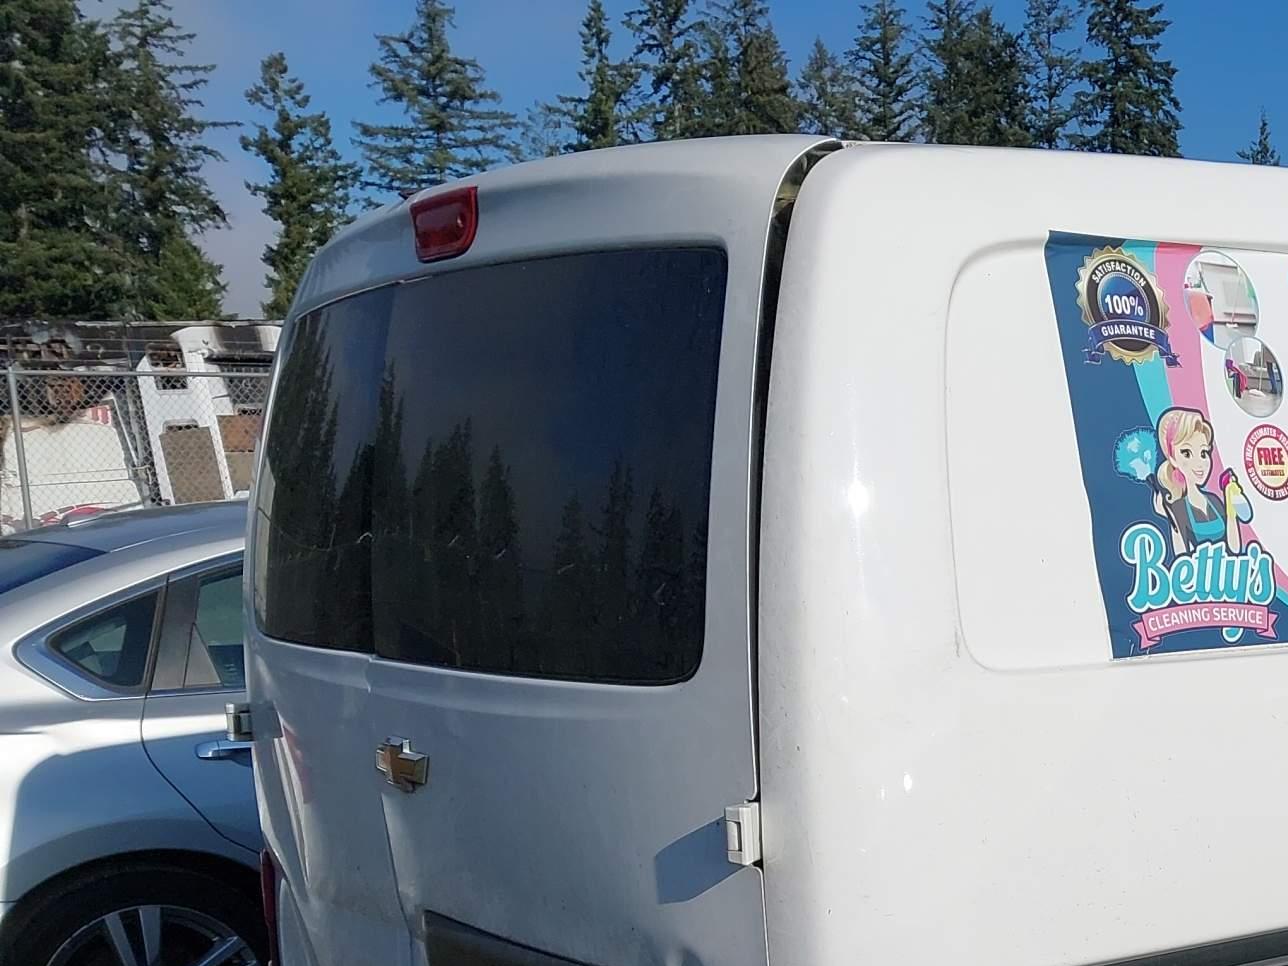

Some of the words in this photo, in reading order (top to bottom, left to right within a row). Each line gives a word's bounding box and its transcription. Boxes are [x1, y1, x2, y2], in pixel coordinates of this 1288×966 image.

[1092, 261, 1147, 287] SATISFACTION
[1104, 294, 1144, 317] 100%
[1101, 325, 1156, 340] GUARANTEE
[1256, 447, 1285, 466] FREE
[1122, 525, 1276, 641] Betty's
[1148, 608, 1211, 632] CLEANING
[1213, 607, 1263, 625] SERVICE
